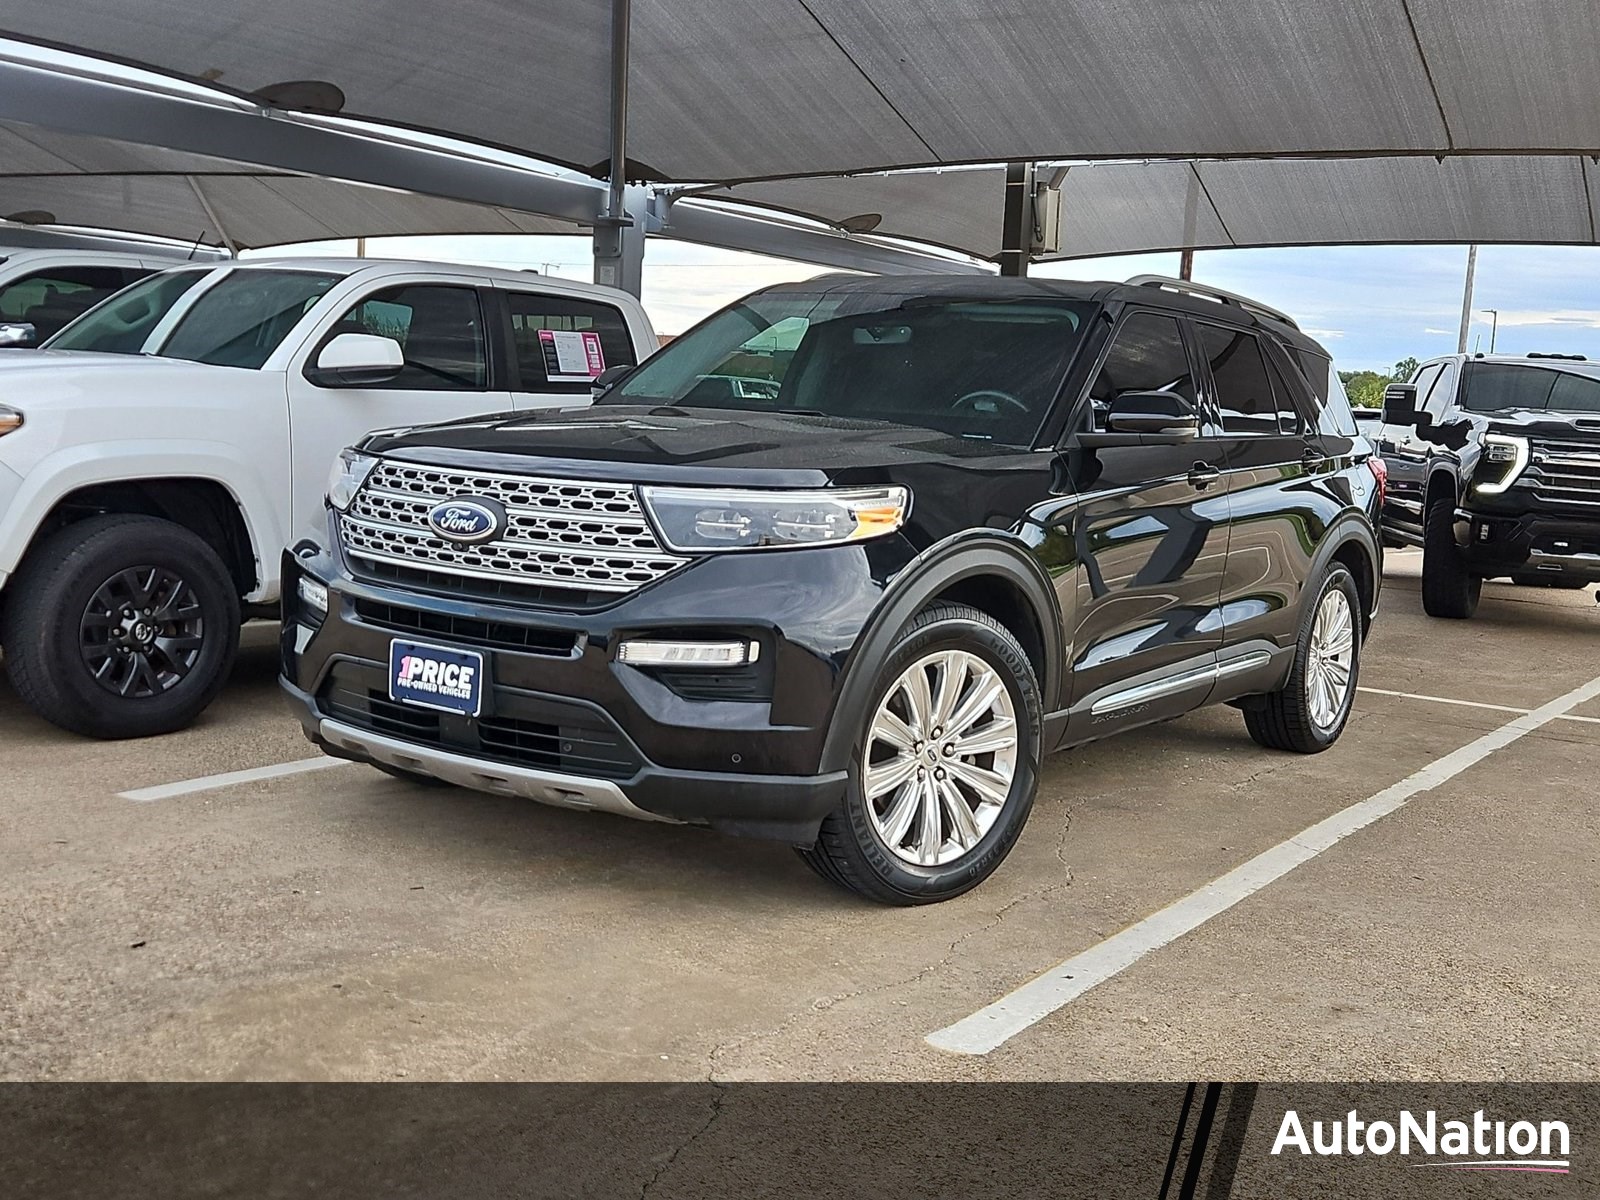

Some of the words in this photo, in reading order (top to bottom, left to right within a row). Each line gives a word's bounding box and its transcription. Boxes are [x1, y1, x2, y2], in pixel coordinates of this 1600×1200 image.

[440, 508, 479, 532] Ford
[397, 677, 437, 693] PRE-OWNED
[438, 684, 471, 700] VEHICLES
